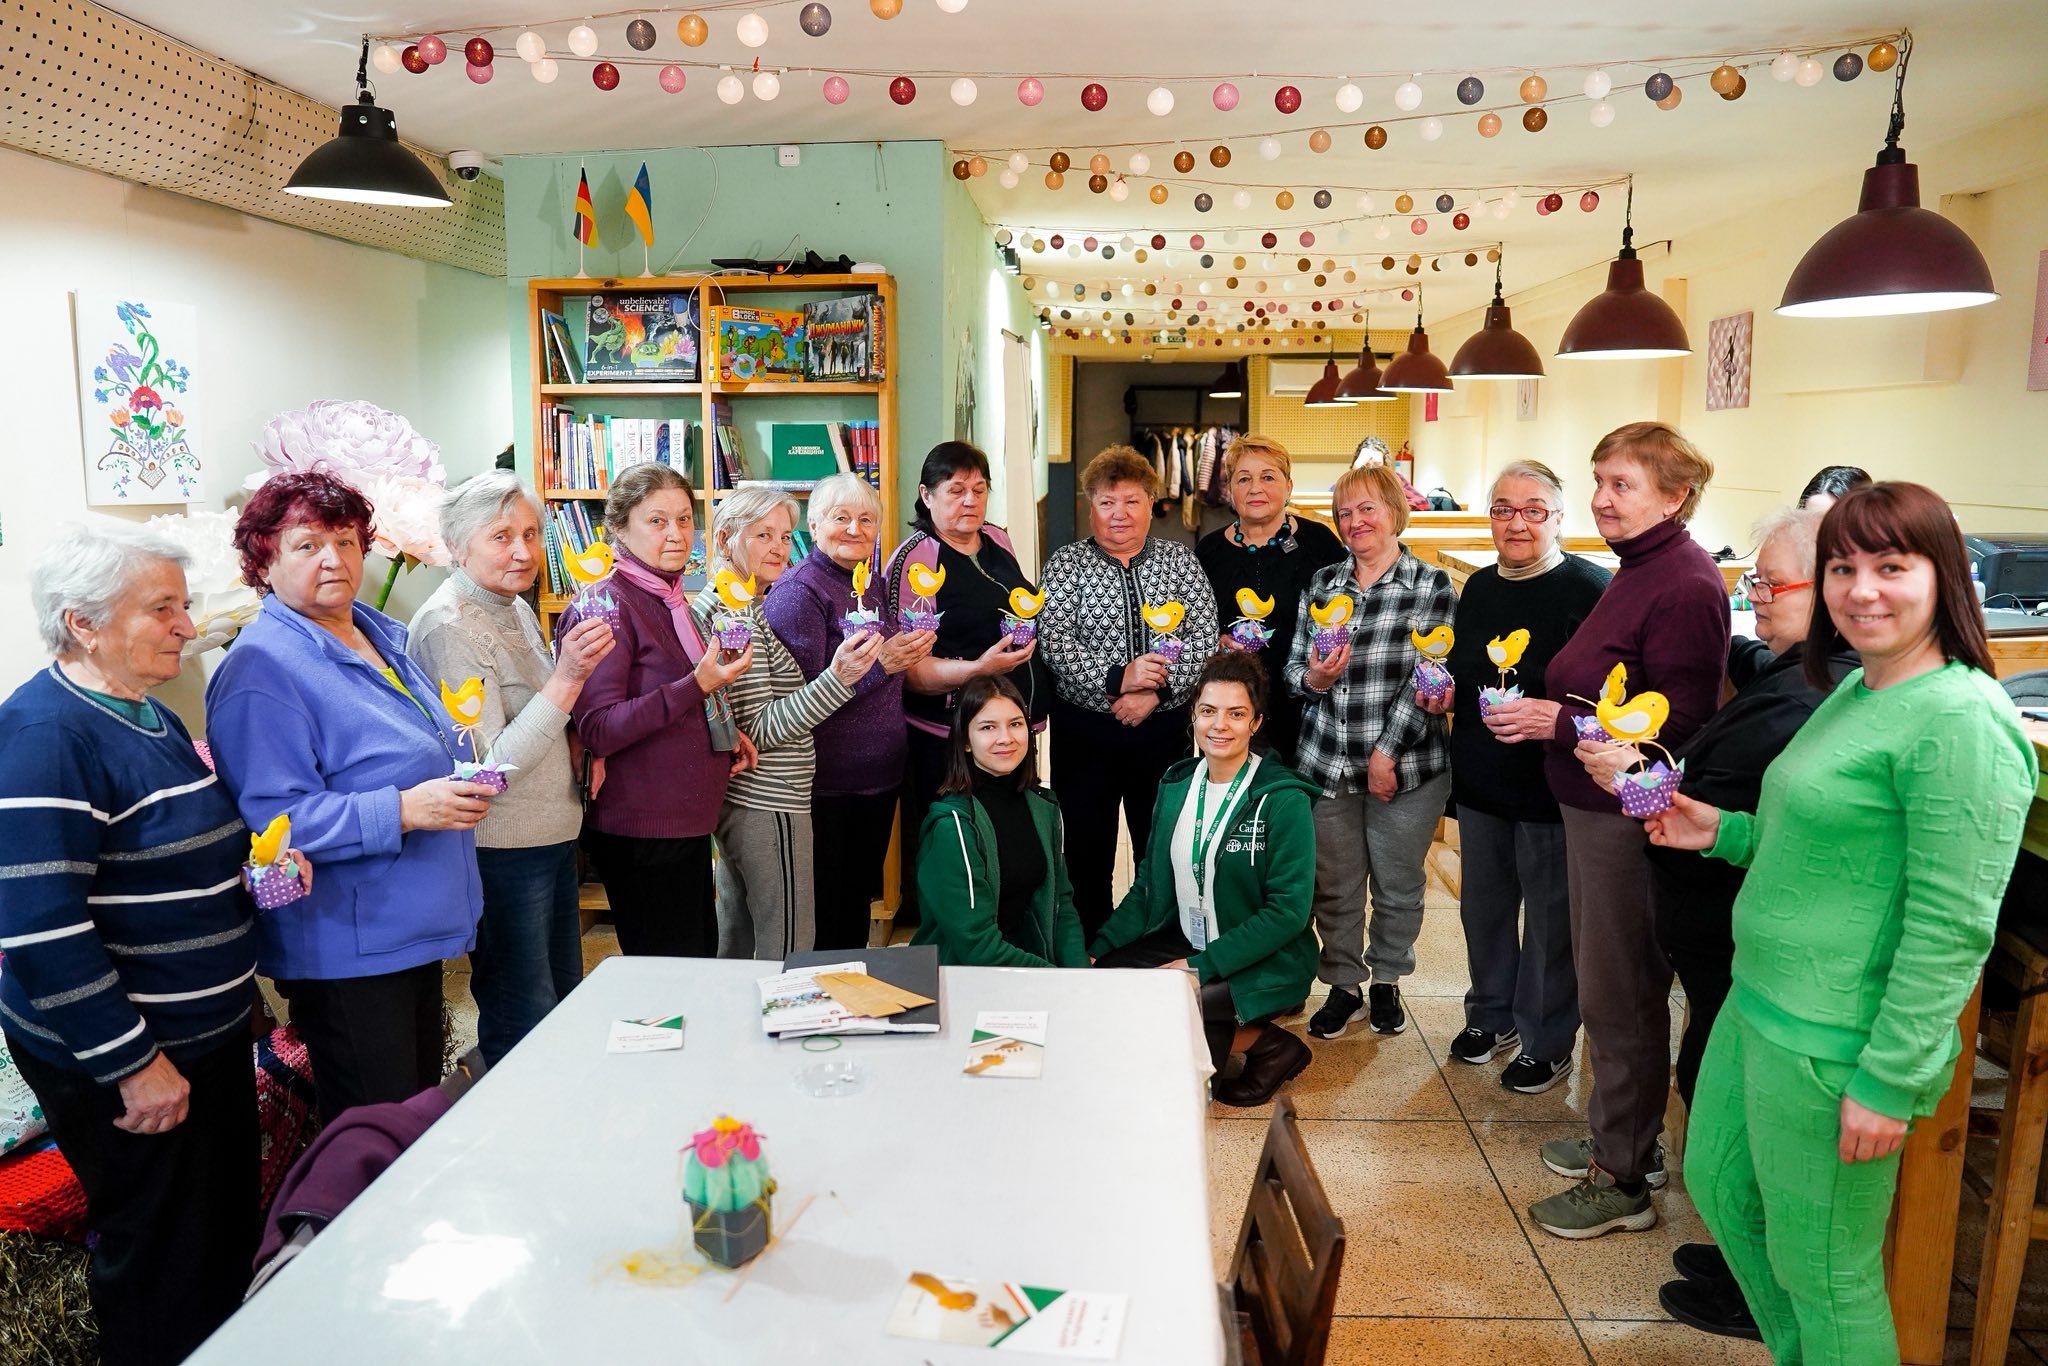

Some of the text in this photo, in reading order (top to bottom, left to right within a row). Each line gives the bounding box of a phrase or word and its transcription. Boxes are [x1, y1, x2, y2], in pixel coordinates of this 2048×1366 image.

[619, 296, 670, 305] unbelievable
[624, 304, 664, 312] SCIENCE
[808, 319, 865, 340] ДЖУМАНДЖИ
